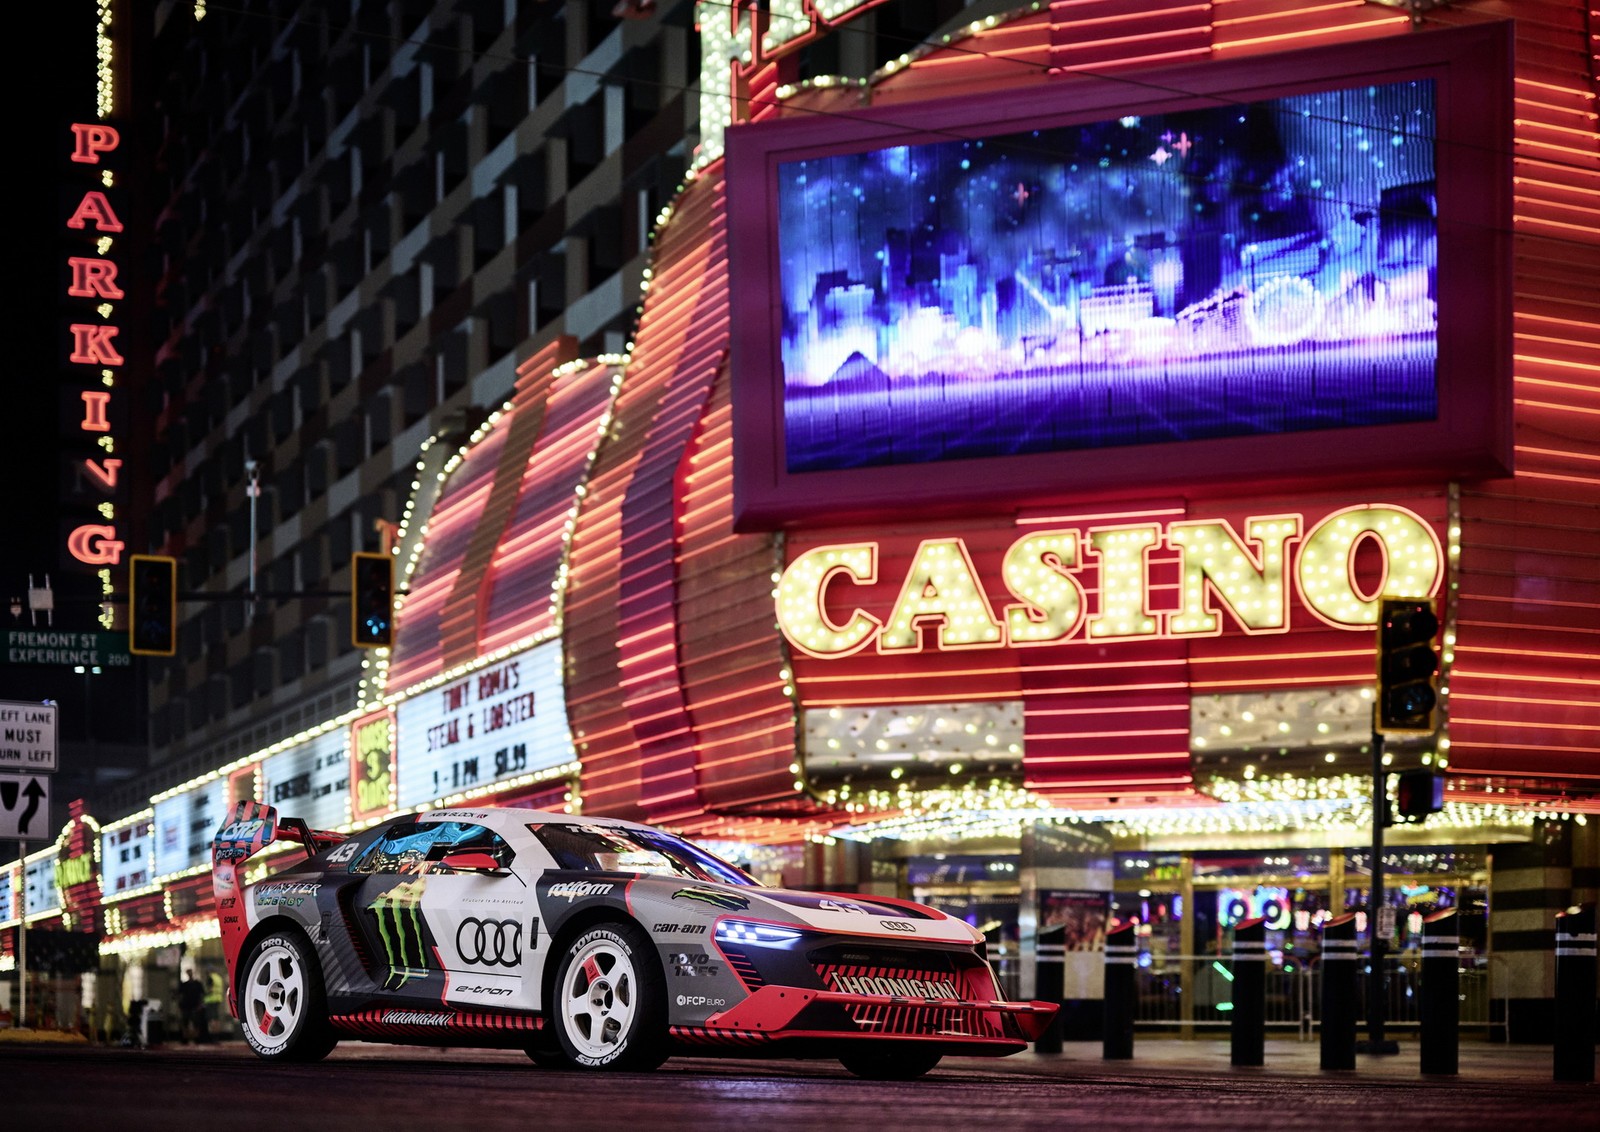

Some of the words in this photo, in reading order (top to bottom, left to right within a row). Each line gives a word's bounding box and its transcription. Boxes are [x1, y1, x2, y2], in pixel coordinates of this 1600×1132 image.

[67, 123, 125, 565] PARKING
[775, 503, 1444, 659] CASINO
[9, 632, 76, 647] FREMONT
[81, 634, 97, 648] ST
[9, 648, 98, 664] EXPERIENCE
[0, 709, 19, 722] EFT
[25, 711, 51, 724] LANE
[5, 728, 41, 743] MUST
[0, 748, 21, 760] URN
[28, 750, 52, 763] LEFT
[221, 820, 264, 841] CSR2
[326, 842, 360, 863] 43
[258, 897, 304, 906] ENERGY
[653, 923, 707, 934] can-am
[669, 953, 709, 965] TOYO
[675, 965, 718, 977] TIRES
[455, 985, 513, 996] e-tron
[686, 996, 706, 1006] FCP
[707, 998, 726, 1006] EURO
